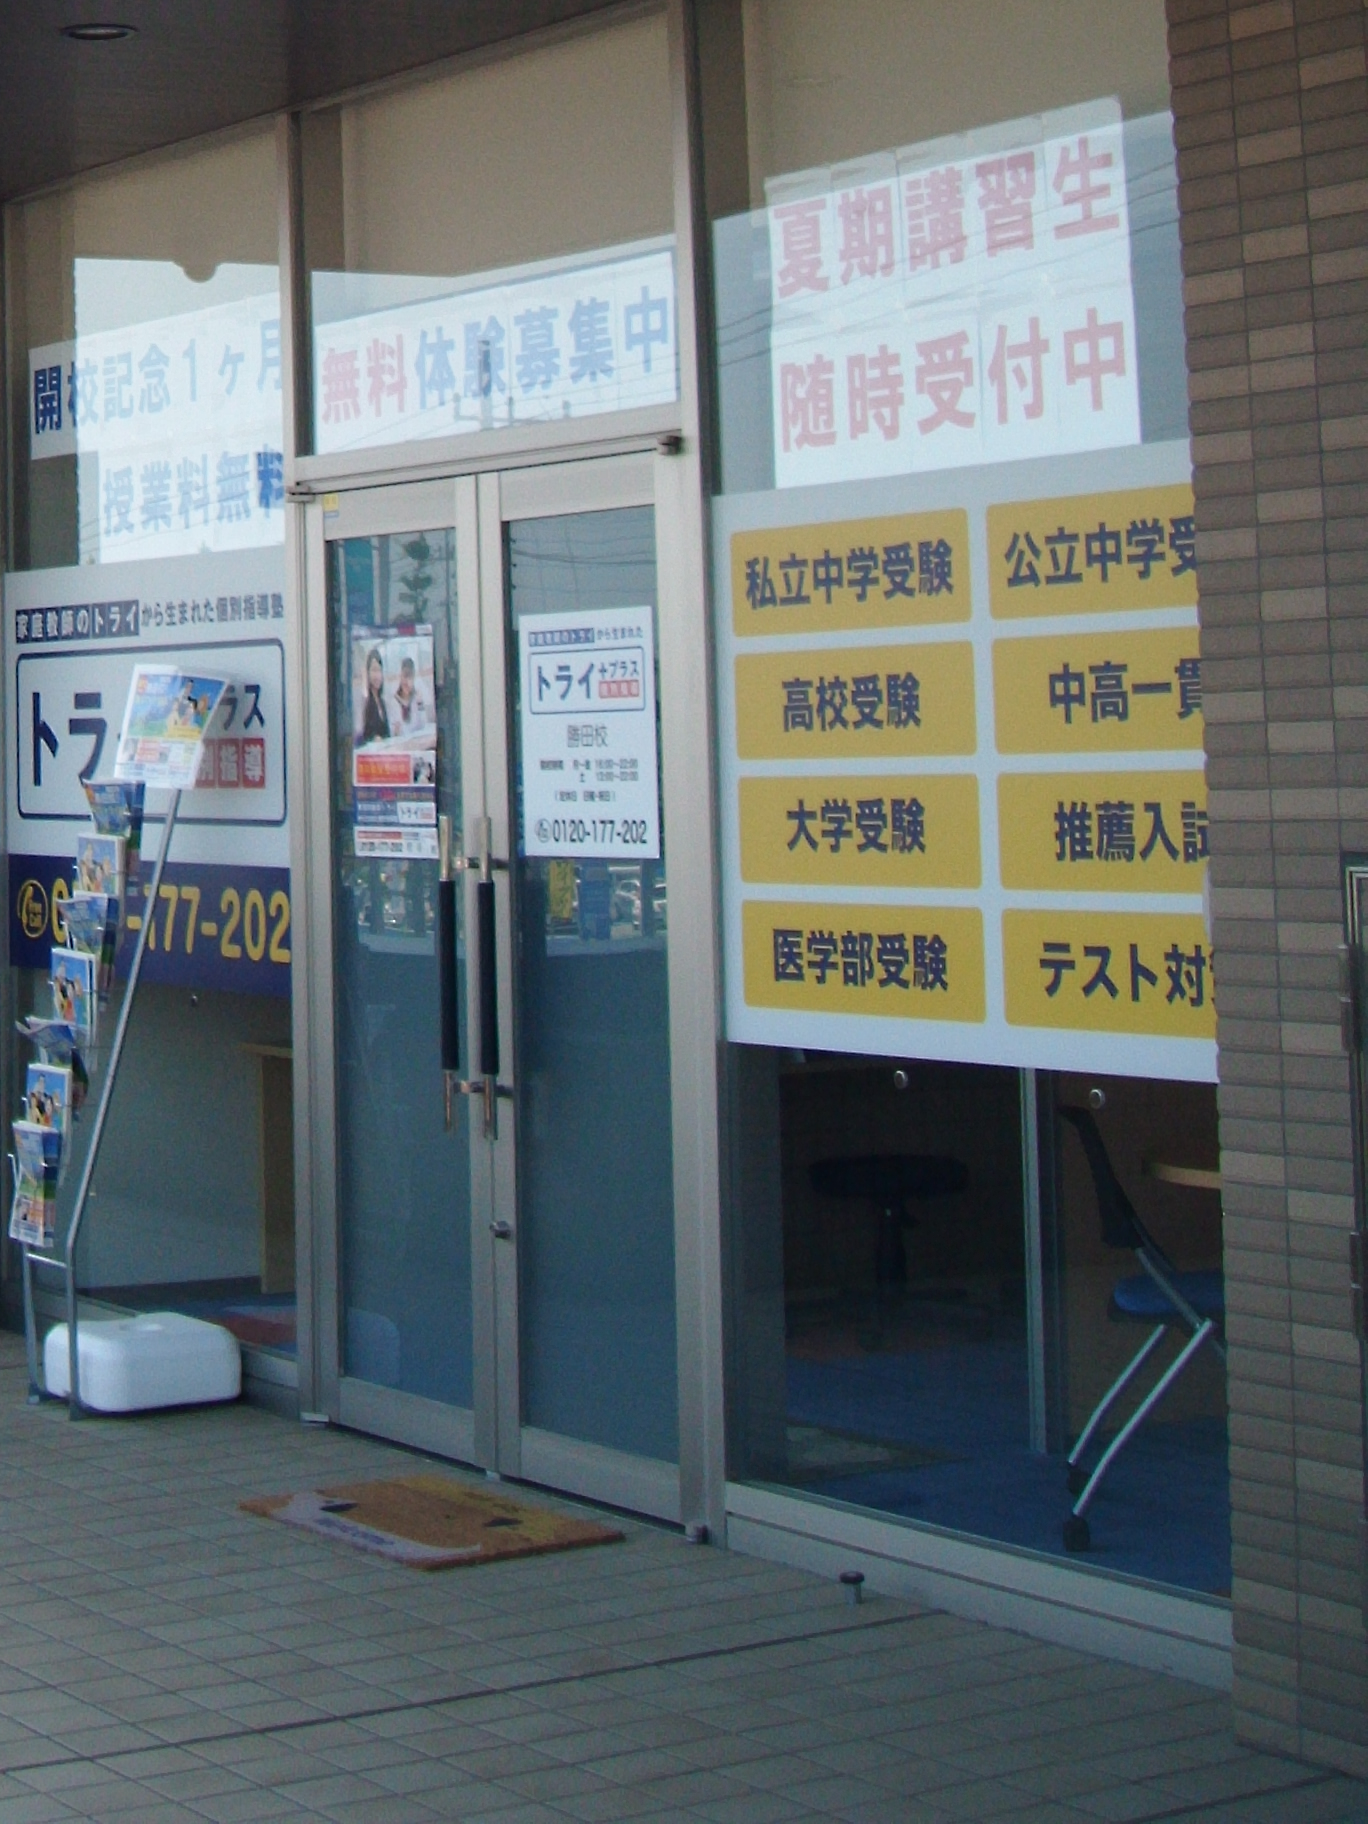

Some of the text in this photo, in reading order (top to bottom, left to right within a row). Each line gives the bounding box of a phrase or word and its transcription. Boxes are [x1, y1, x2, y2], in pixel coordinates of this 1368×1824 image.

[773, 136, 1121, 299] 夏期講習生
[321, 285, 669, 425] 無料体験募集中
[779, 307, 1127, 453] 随時受付中
[745, 538, 954, 610] 私立中学受験
[782, 672, 922, 733] 高校受験
[552, 819, 648, 844] 0120-177-202
[786, 797, 926, 854] 大学受験
[773, 928, 948, 991] 医学部受験
[1039, 942, 1215, 1008] テスト対
